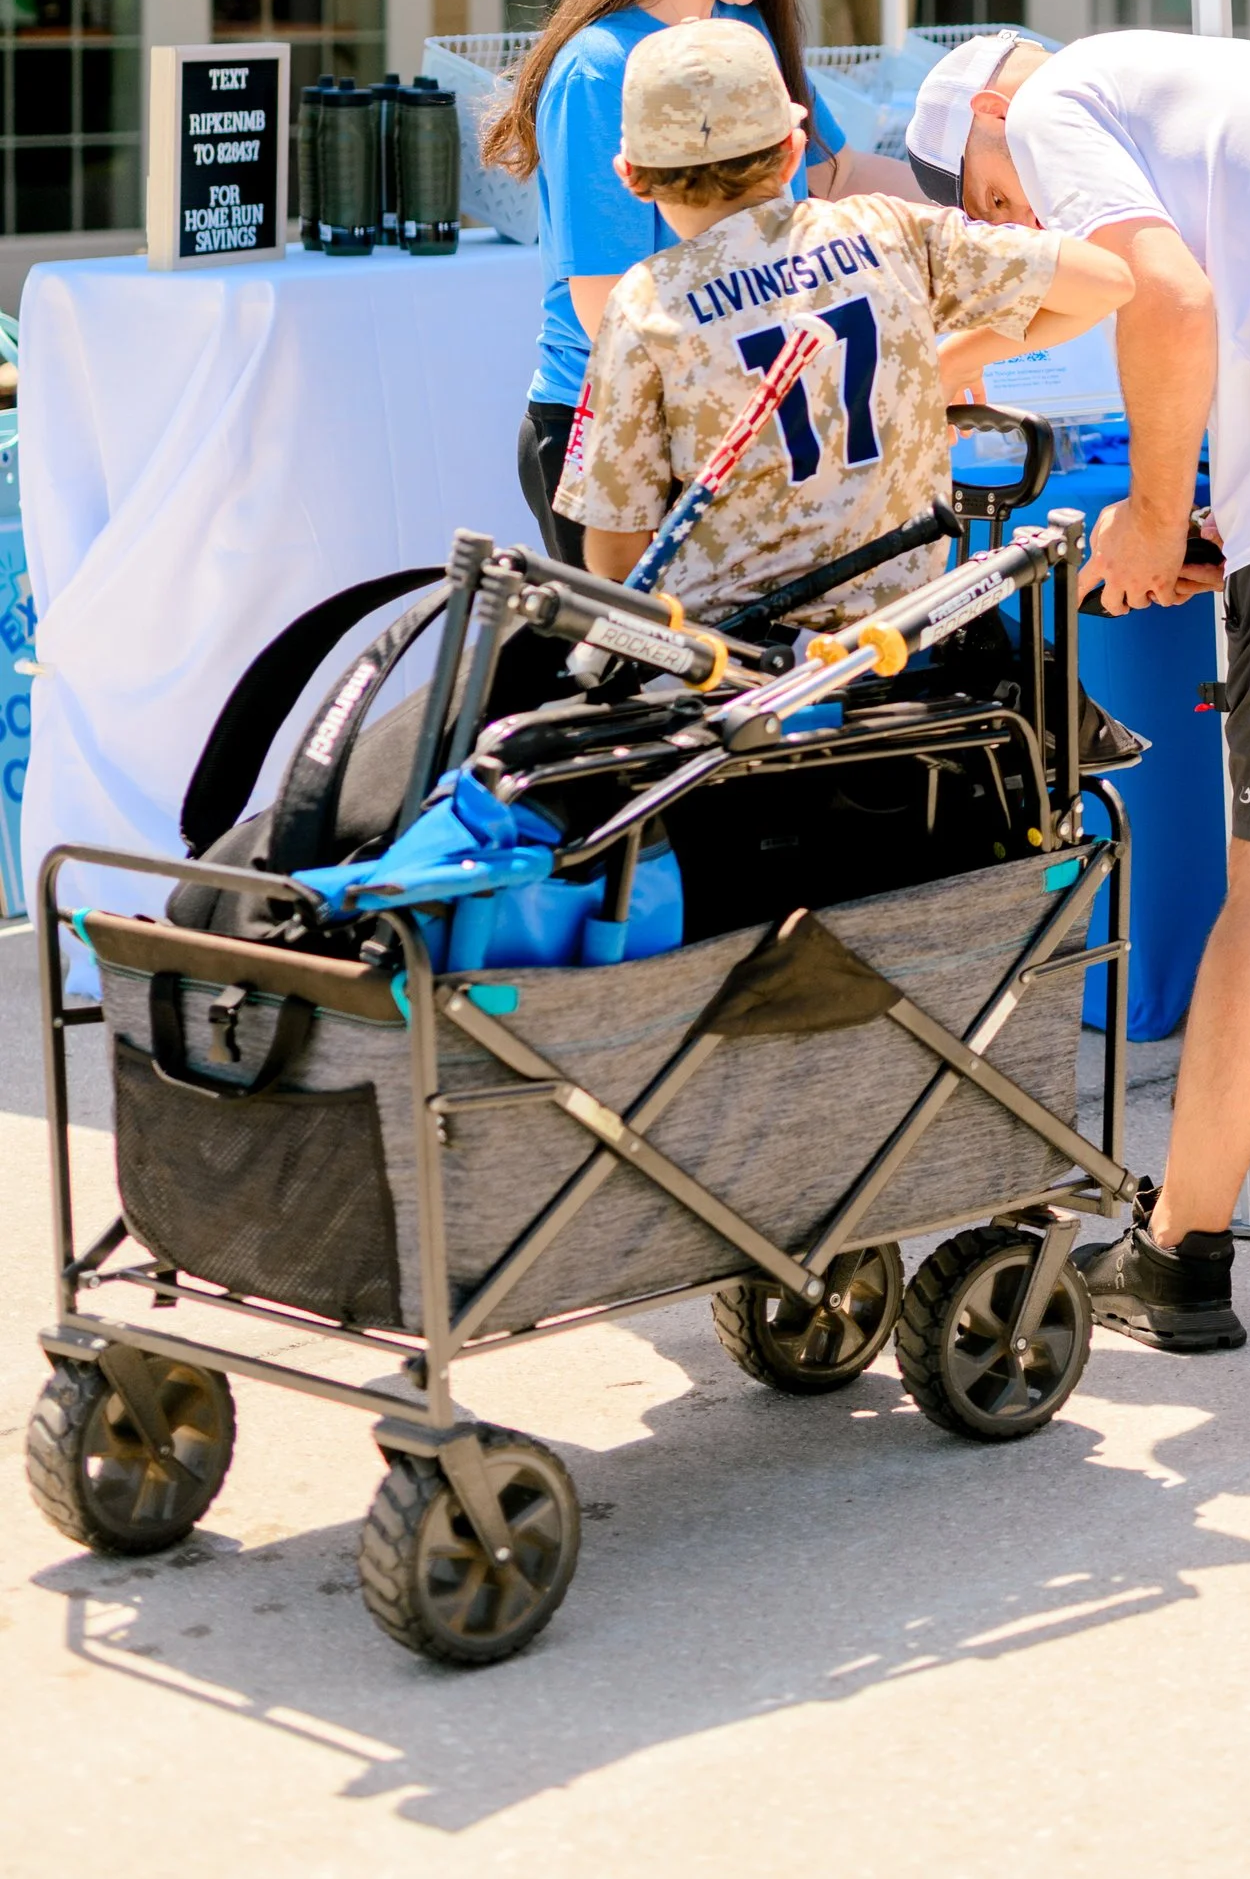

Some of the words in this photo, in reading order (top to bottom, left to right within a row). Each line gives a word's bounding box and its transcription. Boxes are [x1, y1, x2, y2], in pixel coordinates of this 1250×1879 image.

[208, 67, 249, 91] TEXT
[189, 109, 266, 136] RIPKENMB
[193, 143, 215, 166] TO
[209, 184, 240, 208] FOR
[184, 206, 229, 232] HOME
[231, 203, 264, 227] RUN
[195, 226, 257, 253] SAVINGS
[686, 233, 882, 325] LIVINGSTON
[733, 293, 882, 486] 17
[928, 571, 1003, 625] FREESTYLE
[602, 627, 681, 666] ROCKER
[305, 663, 377, 766] marucci
